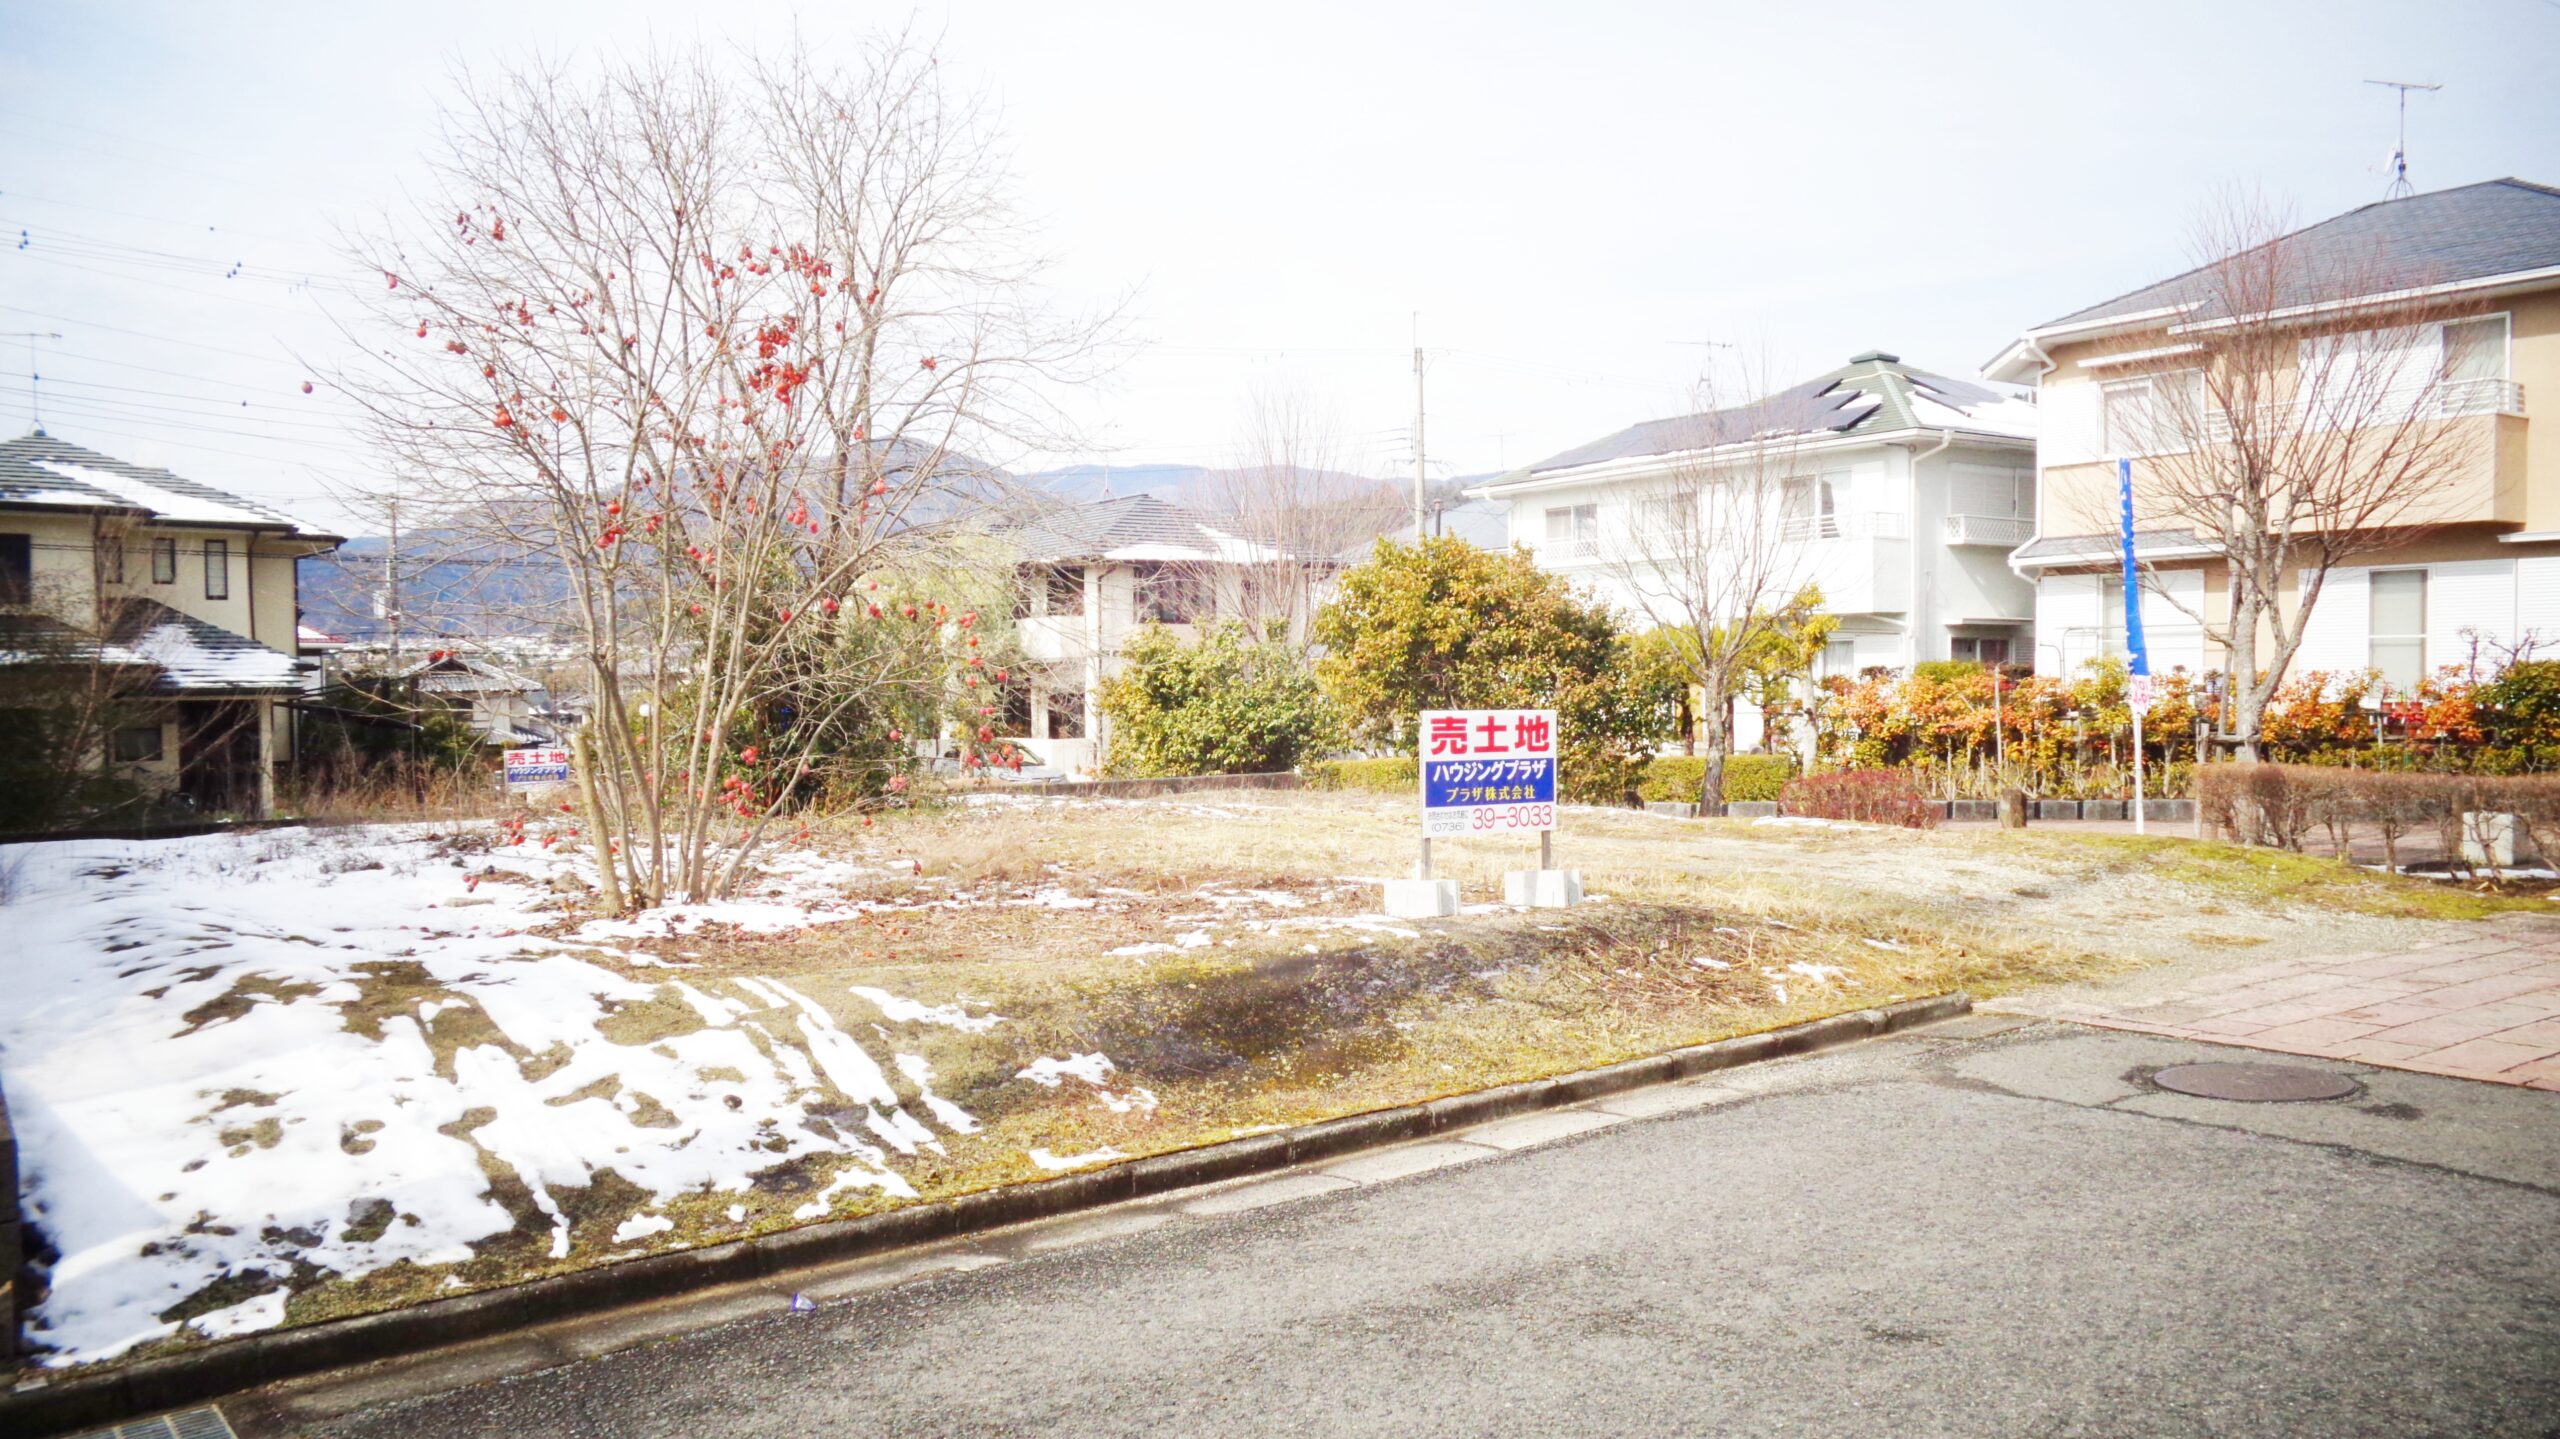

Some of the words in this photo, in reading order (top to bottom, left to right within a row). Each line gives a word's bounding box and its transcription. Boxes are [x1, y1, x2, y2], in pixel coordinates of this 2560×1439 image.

[1430, 715, 1550, 755] 売土地
[508, 751, 566, 765] 売土地
[1433, 759, 1547, 782] ハウジングプラザ
[1446, 785, 1536, 802] プラザ株式会社
[1472, 805, 1553, 830] 39-3033
